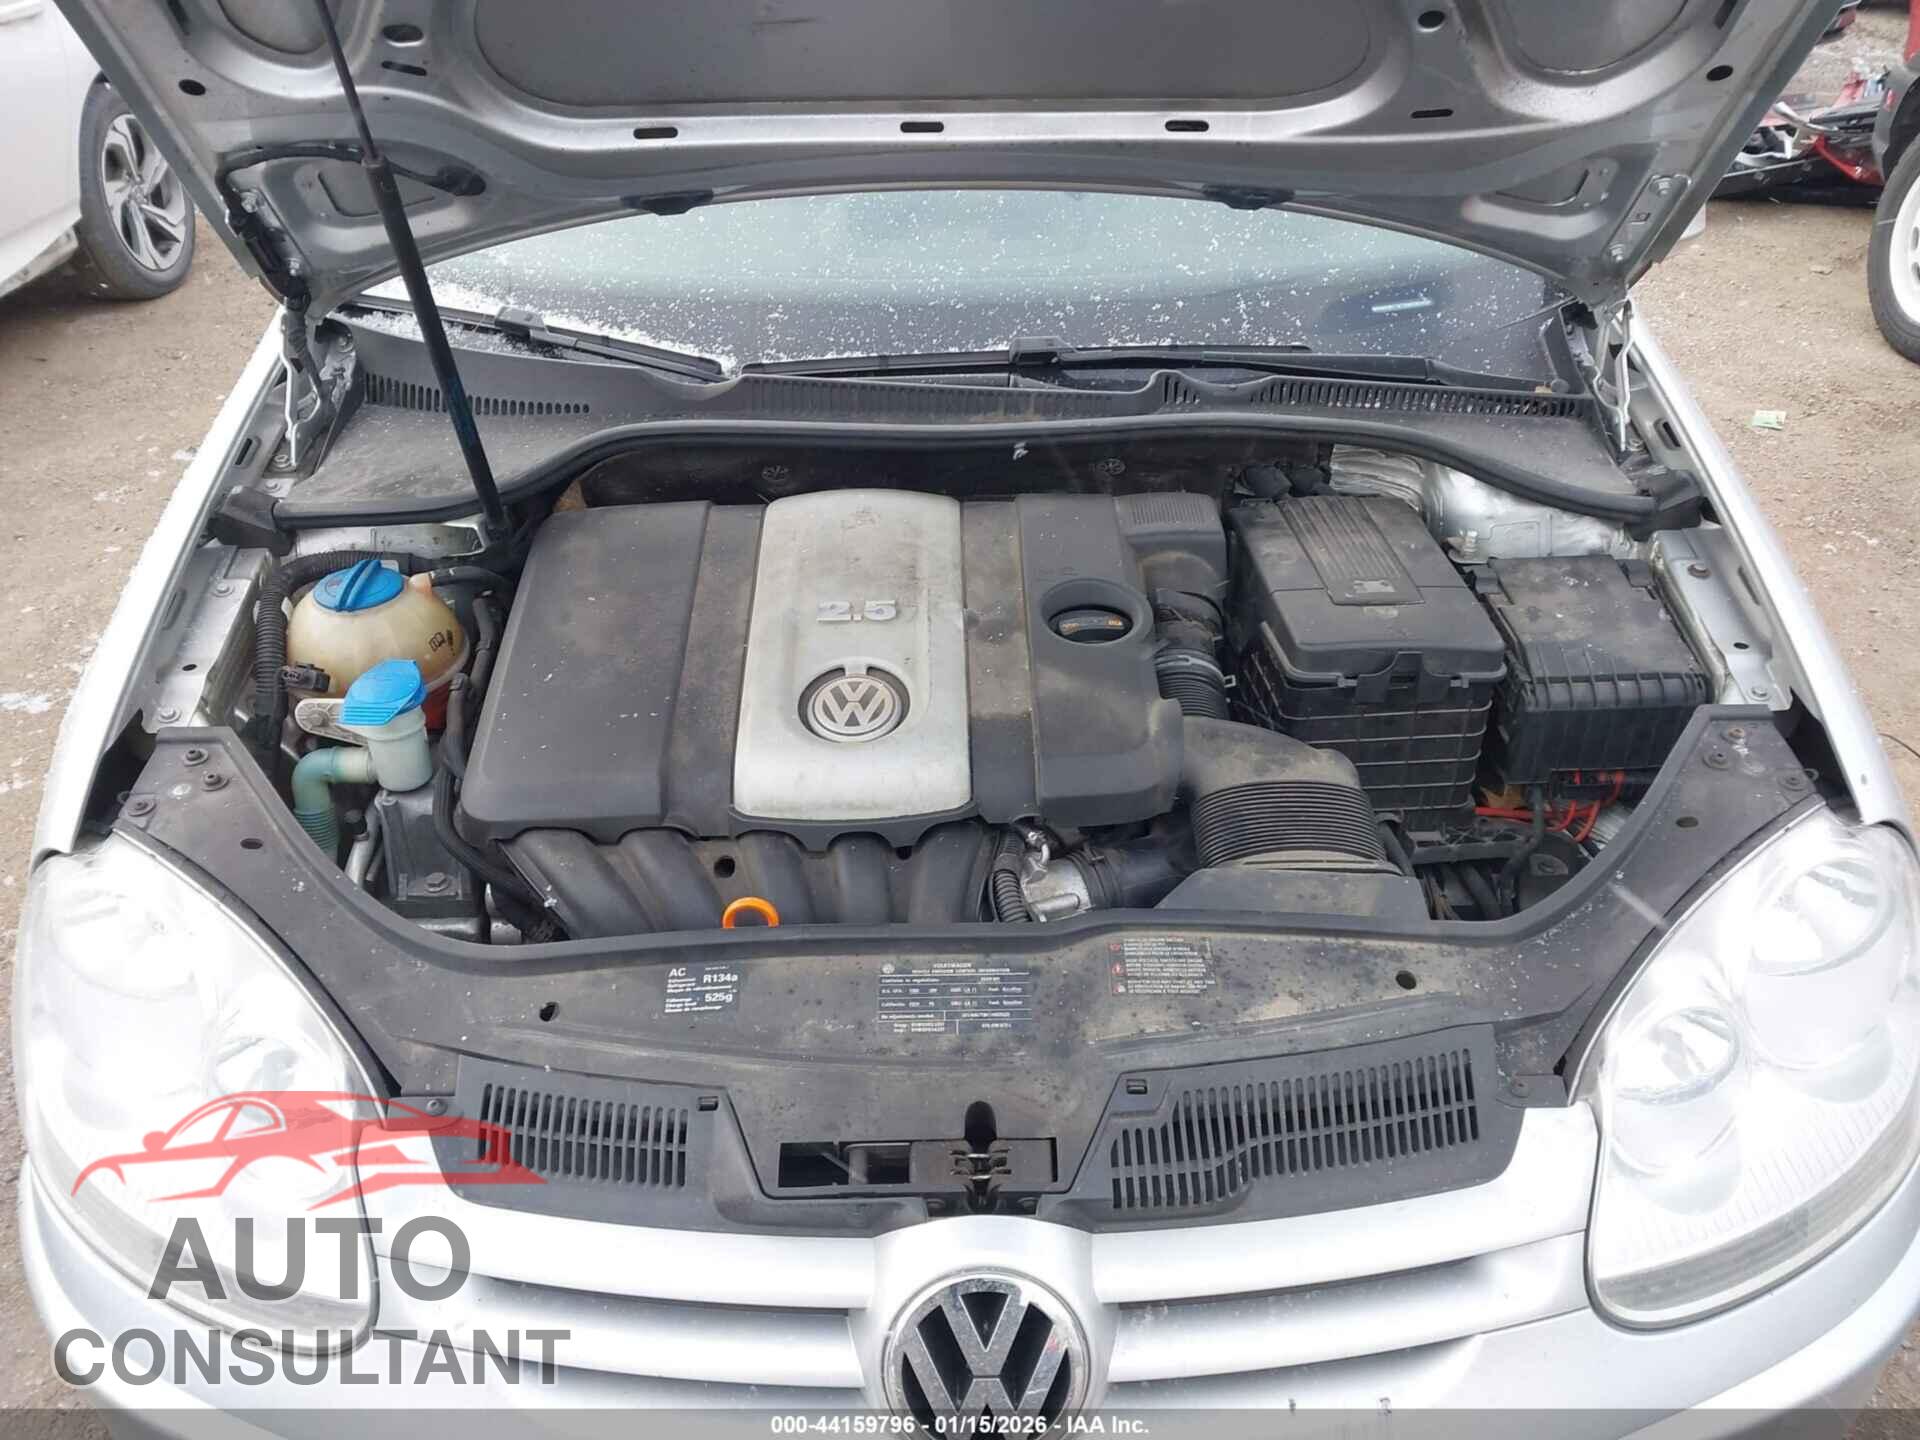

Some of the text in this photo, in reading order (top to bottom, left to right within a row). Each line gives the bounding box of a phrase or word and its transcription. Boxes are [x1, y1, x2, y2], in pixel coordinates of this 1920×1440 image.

[815, 600, 897, 621] 2.5
[668, 967, 687, 978] AC
[703, 973, 738, 984] R134a
[704, 993, 733, 1003] 525g
